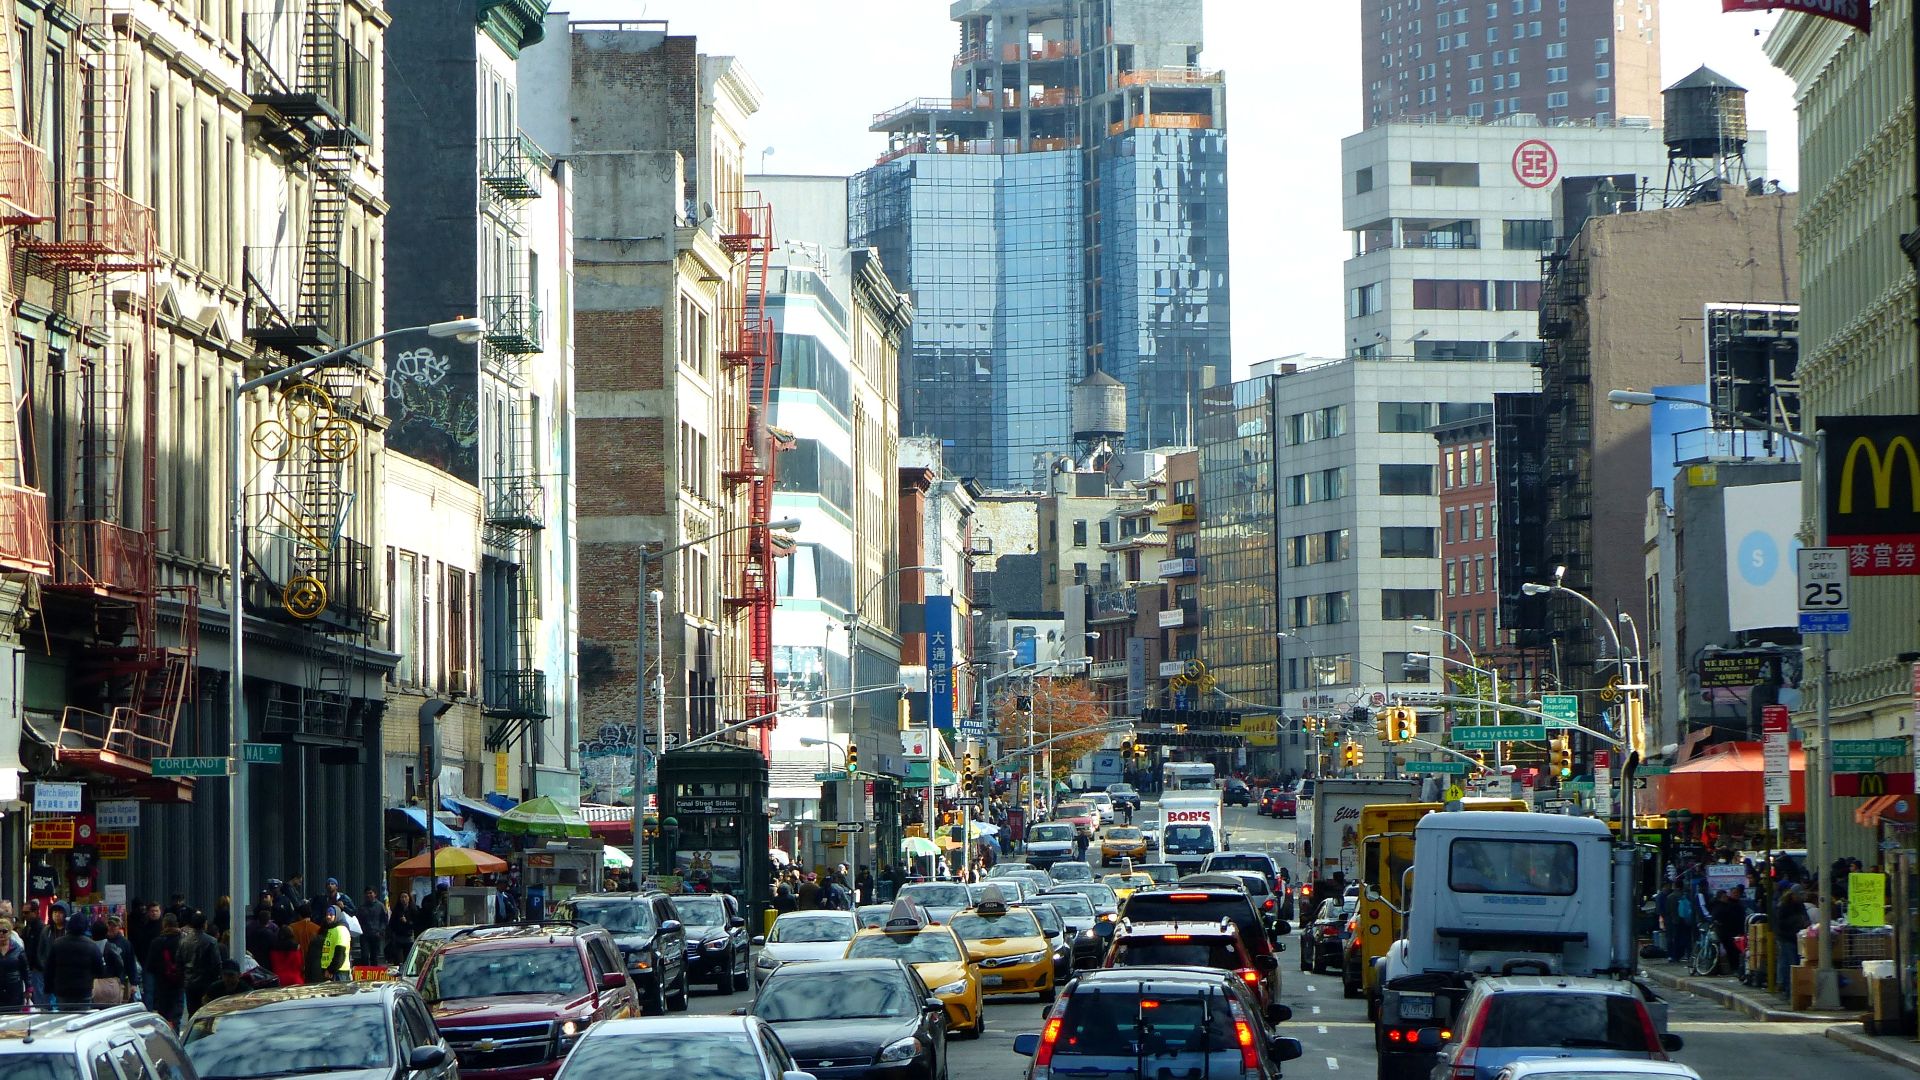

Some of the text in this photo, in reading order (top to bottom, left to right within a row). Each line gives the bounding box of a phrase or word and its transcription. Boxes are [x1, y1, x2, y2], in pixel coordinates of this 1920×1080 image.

[1850, 543, 1916, 568] 麥當勞
[1805, 583, 1842, 606] 25
[932, 631, 946, 694] 大通銀行
[1143, 709, 1240, 725] WELCOME
[1463, 729, 1535, 740] Lafayette St
[1160, 734, 1243, 747] CHINATOWN
[268, 747, 277, 755] ST
[1834, 743, 1876, 753] Cortlandt
[159, 759, 219, 769] CORTLANDT
[37, 788, 80, 799] Watch Repair
[117, 804, 138, 815] Repair
[1333, 806, 1360, 823] Elite
[1167, 811, 1211, 823] BOB'S
[534, 897, 541, 906] P
[354, 971, 364, 980] WE
[367, 970, 379, 980] BUY
